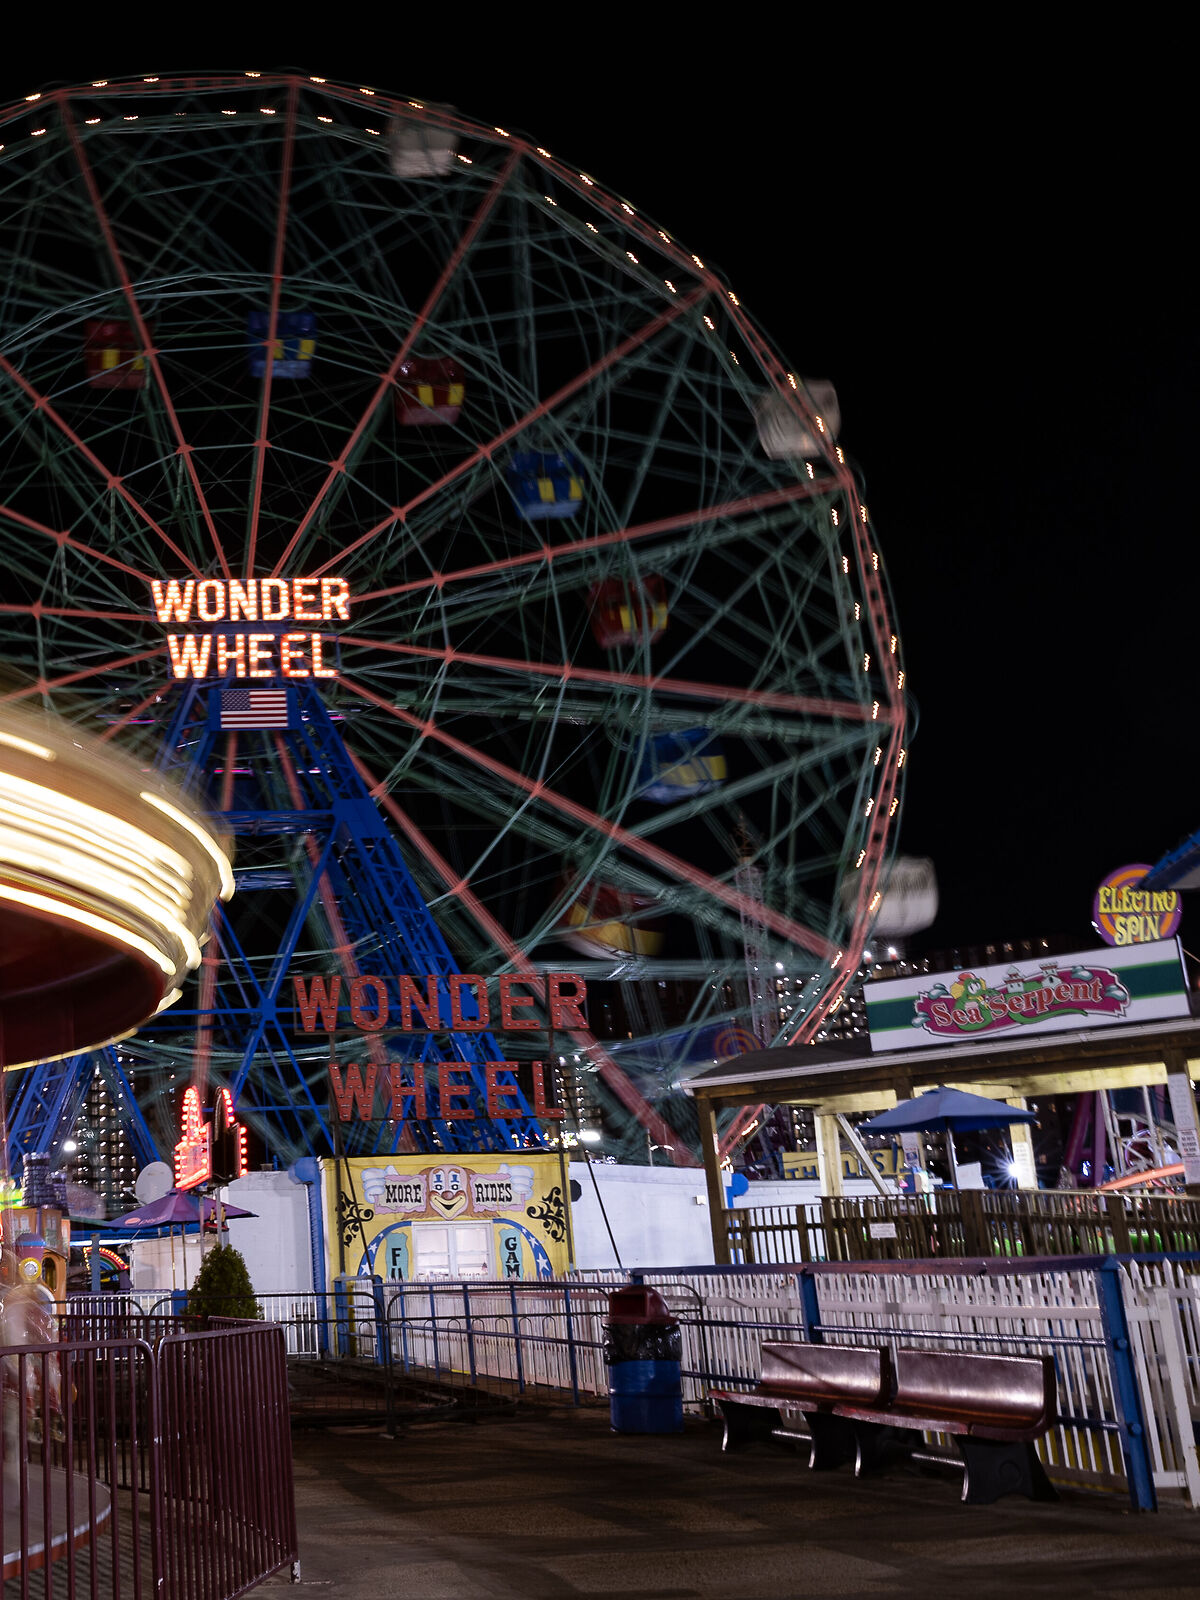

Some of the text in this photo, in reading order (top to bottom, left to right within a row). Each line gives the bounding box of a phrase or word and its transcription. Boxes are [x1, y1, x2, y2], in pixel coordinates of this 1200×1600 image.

[151, 577, 350, 623] WONDER
[167, 633, 339, 678] WHEEL
[1114, 915, 1160, 945] SPIN
[294, 973, 589, 1032] WONDER
[930, 976, 1102, 1026] Sea Serpent
[328, 1061, 565, 1121] WHEEL
[385, 1183, 513, 1203] MORE RIDES
